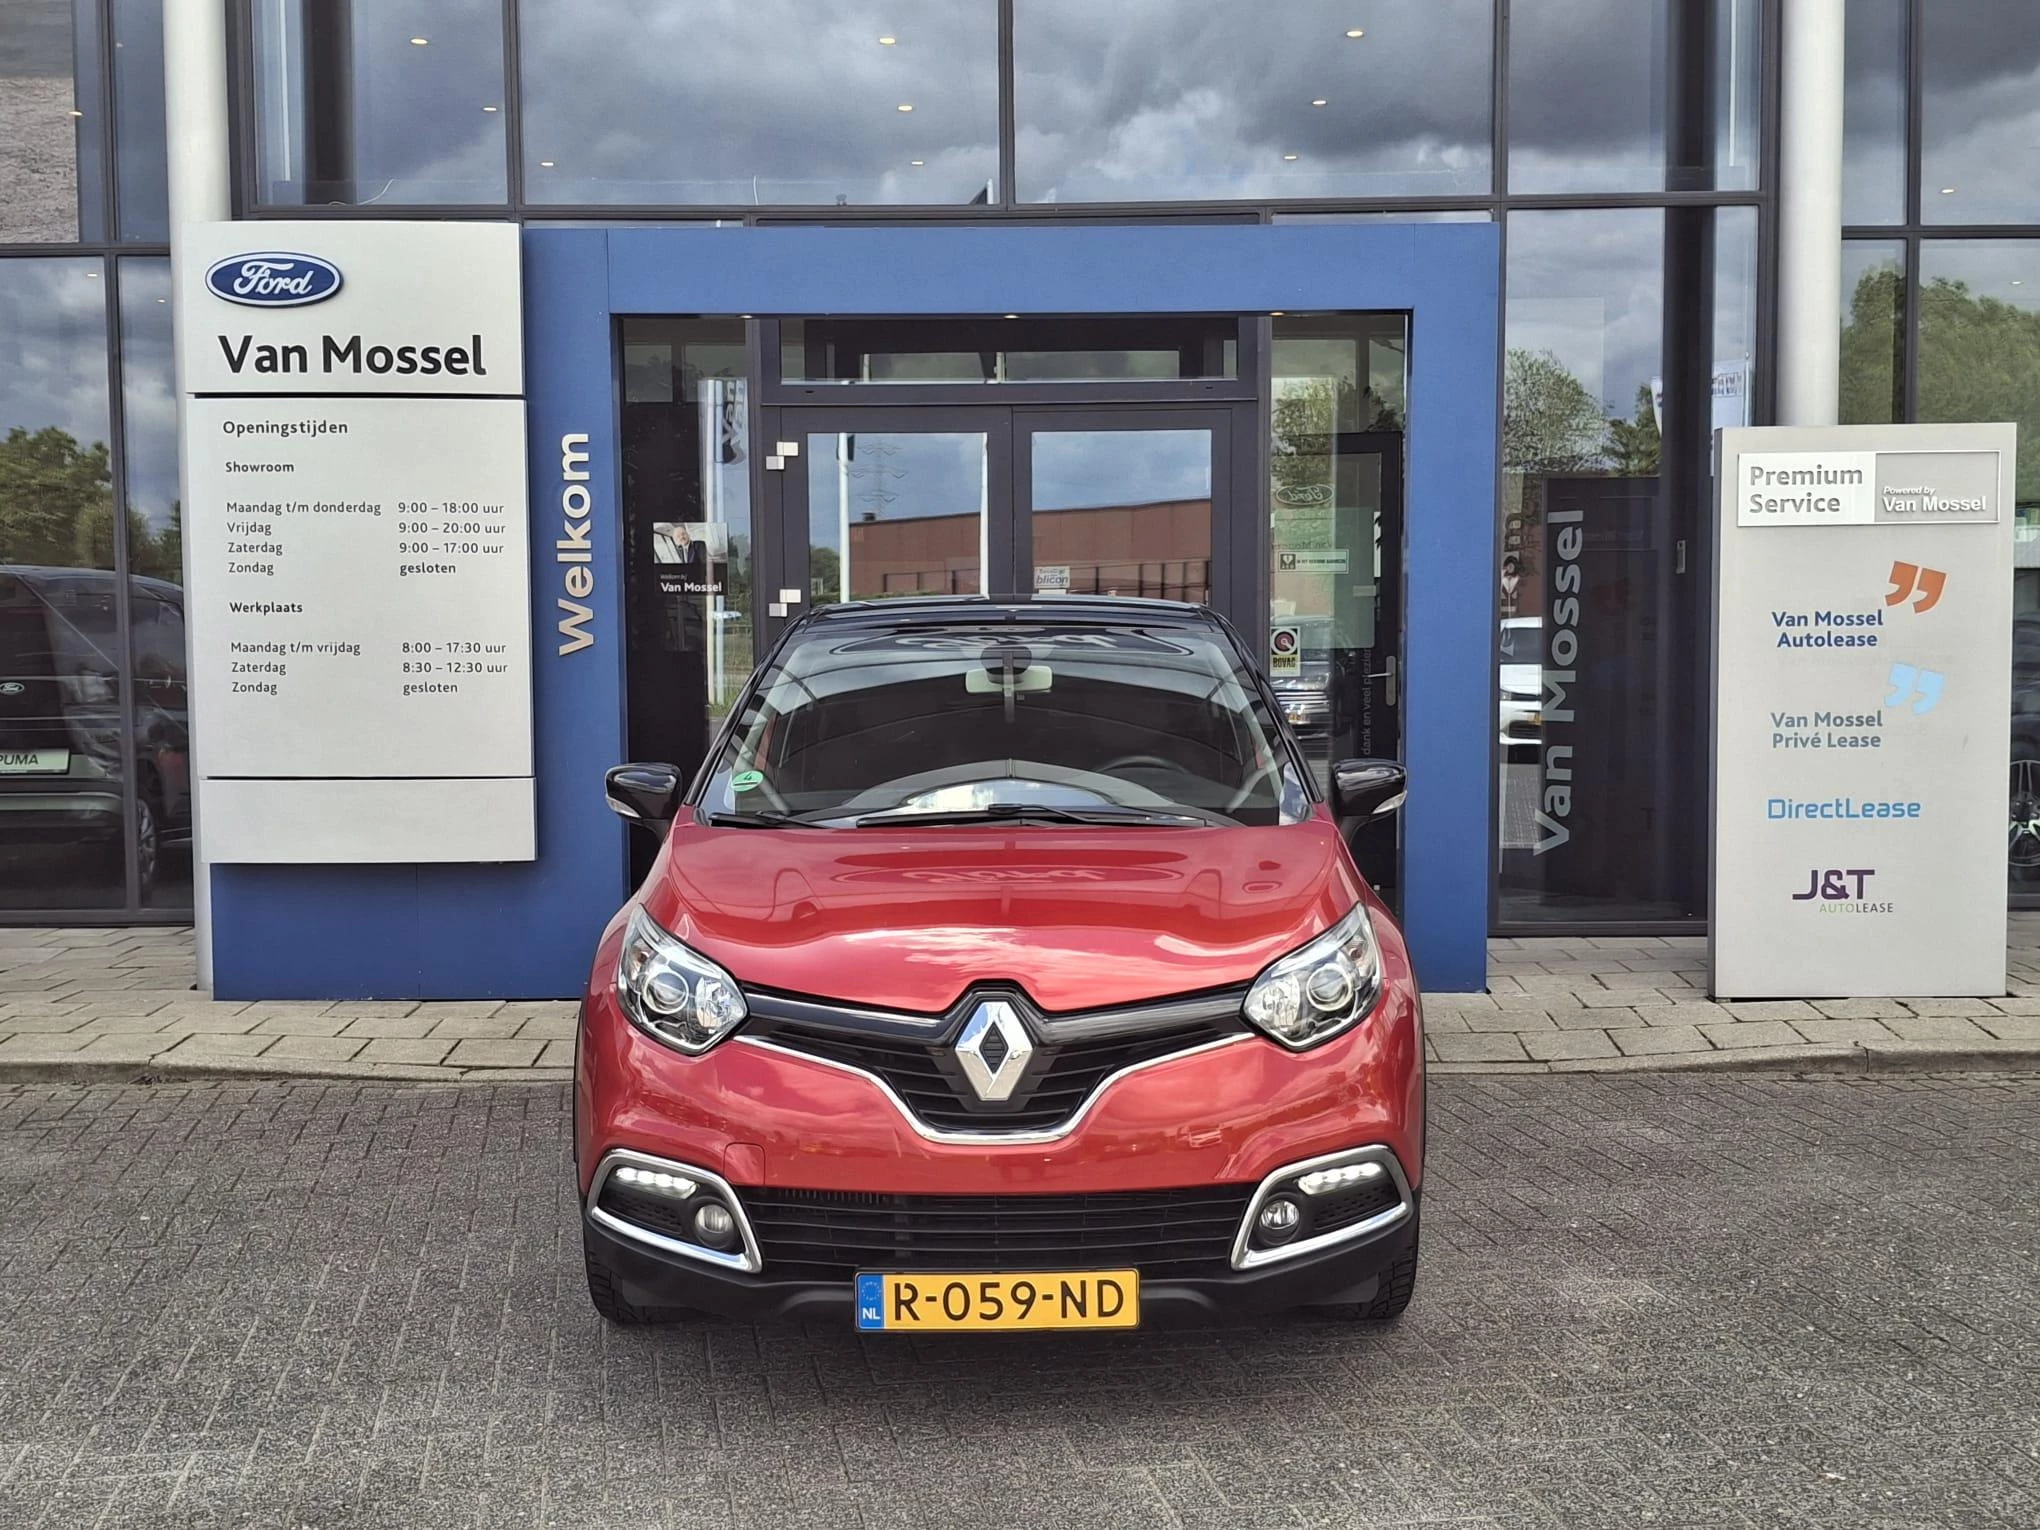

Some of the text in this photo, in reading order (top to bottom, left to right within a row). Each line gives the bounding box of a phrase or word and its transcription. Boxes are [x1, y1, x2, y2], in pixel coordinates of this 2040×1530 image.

[234, 261, 314, 295] Ford
[218, 334, 487, 375] Van Mossel
[223, 421, 348, 437] Openingstijden
[226, 461, 294, 473] Showroom
[1750, 464, 1863, 486] Premium
[1883, 486, 1935, 497] Powered by
[226, 502, 282, 516] Maandag
[286, 502, 309, 513] t/m
[313, 502, 381, 516] donderdag
[398, 502, 427, 513] 9:00
[442, 502, 479, 513] 18:00
[483, 504, 504, 514] uur
[1749, 492, 1841, 513] Service
[1882, 495, 1986, 512] Van Mossel
[227, 522, 271, 536] Vrijdag
[399, 523, 428, 533] 9:00
[443, 523, 480, 533] 20:00
[485, 525, 506, 534] uur
[228, 542, 282, 556] Zaterdag
[399, 543, 428, 553] 9:00
[444, 543, 478, 553] 17:00
[483, 545, 504, 554] uur
[556, 434, 594, 656] Welkom
[229, 562, 456, 577] Zondag gesloten
[660, 581, 722, 592] Van Mossel
[229, 602, 303, 616] Werkplaats
[1771, 609, 1883, 627] Van Mossel
[1777, 631, 1878, 648] Autolease
[231, 642, 286, 656] Maandag
[290, 642, 313, 653] t/m
[317, 642, 361, 656] vrijdag
[402, 643, 431, 653] 8:00
[446, 643, 480, 653] 17:30
[485, 645, 506, 654] uur
[232, 662, 286, 675] Zaterdag
[403, 662, 431, 672] 8:30
[447, 662, 482, 672] 12:30
[487, 664, 508, 674] uur
[232, 682, 458, 695] Zondag gesloten
[1533, 510, 1584, 856] Van Mossel
[1771, 710, 1883, 728] Van Mossel
[1772, 732, 1881, 748] Privé Lease
[1767, 798, 1921, 819] DirectLease
[1792, 869, 1875, 900] J&T
[1819, 902, 1894, 913] AUTOLEASE
[862, 1279, 1124, 1321] NL R-059-ND
